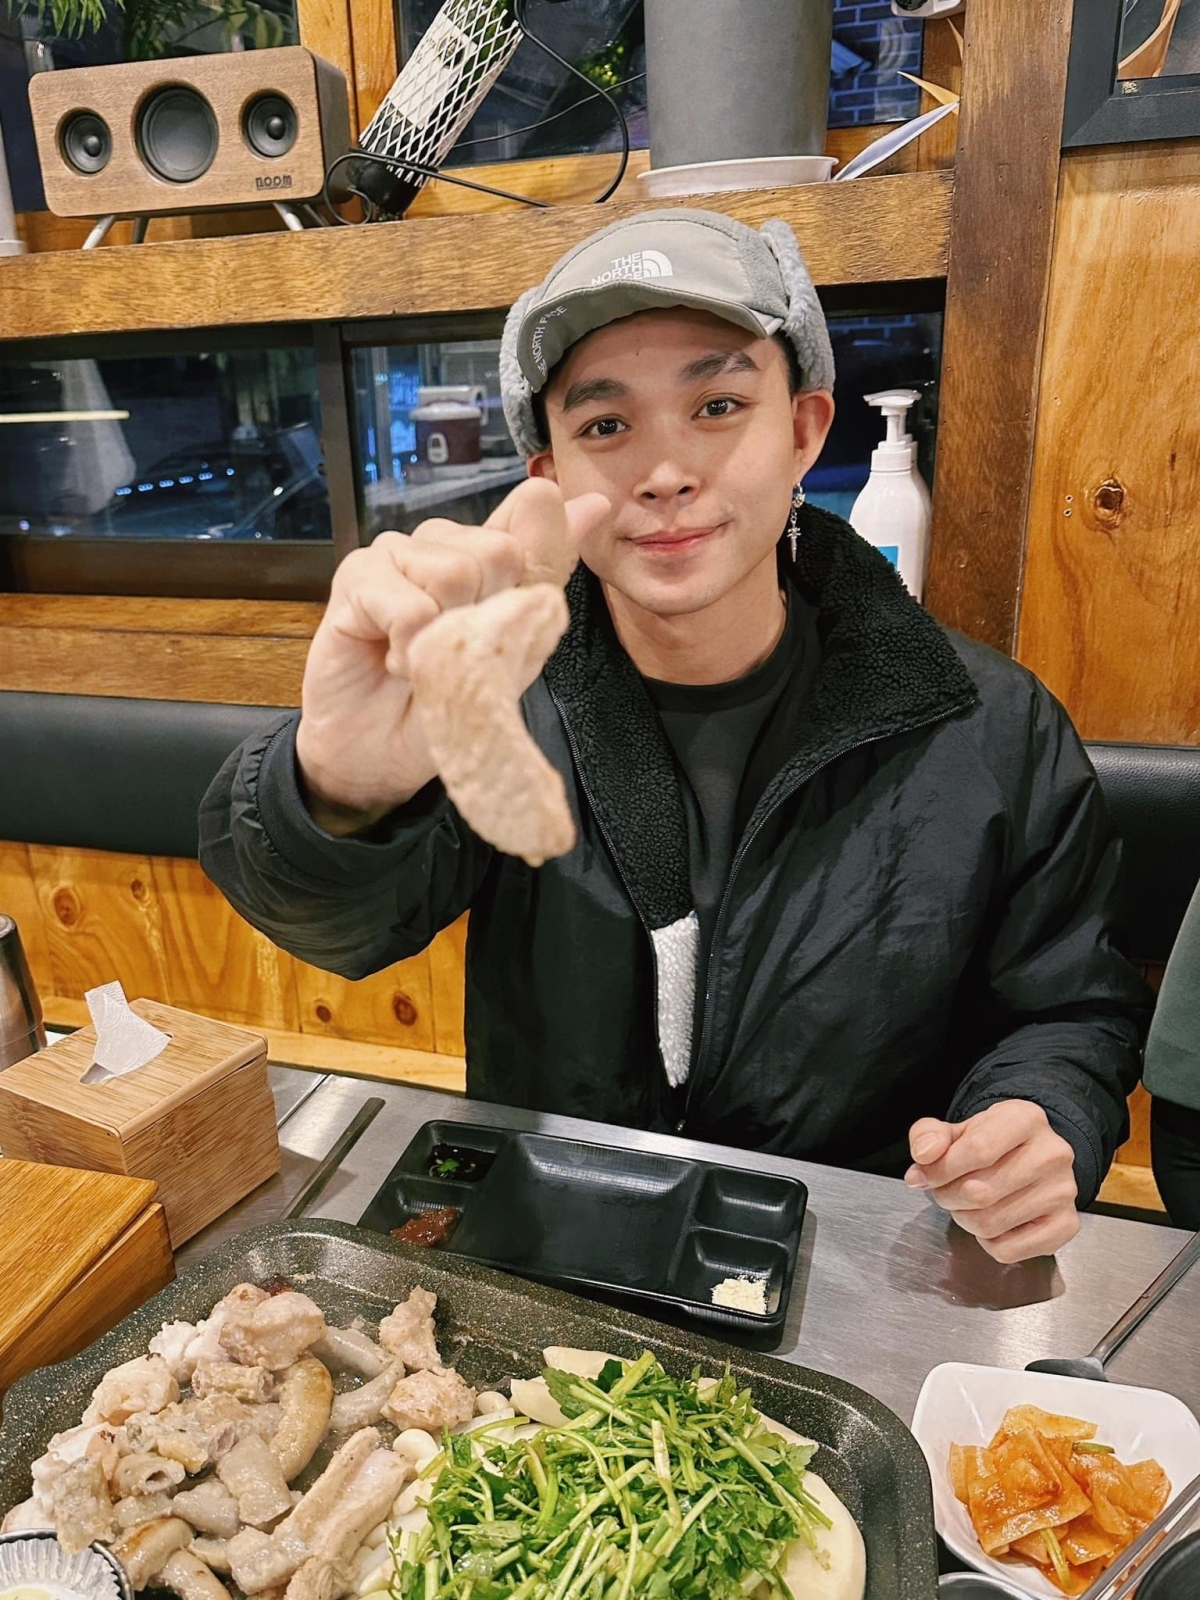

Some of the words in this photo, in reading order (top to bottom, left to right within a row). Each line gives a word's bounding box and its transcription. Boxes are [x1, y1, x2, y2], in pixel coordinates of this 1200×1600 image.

[591, 260, 643, 286] NORTH
[611, 251, 642, 269] THE
[532, 326, 546, 363] NORTH
[539, 305, 568, 324] FACE
